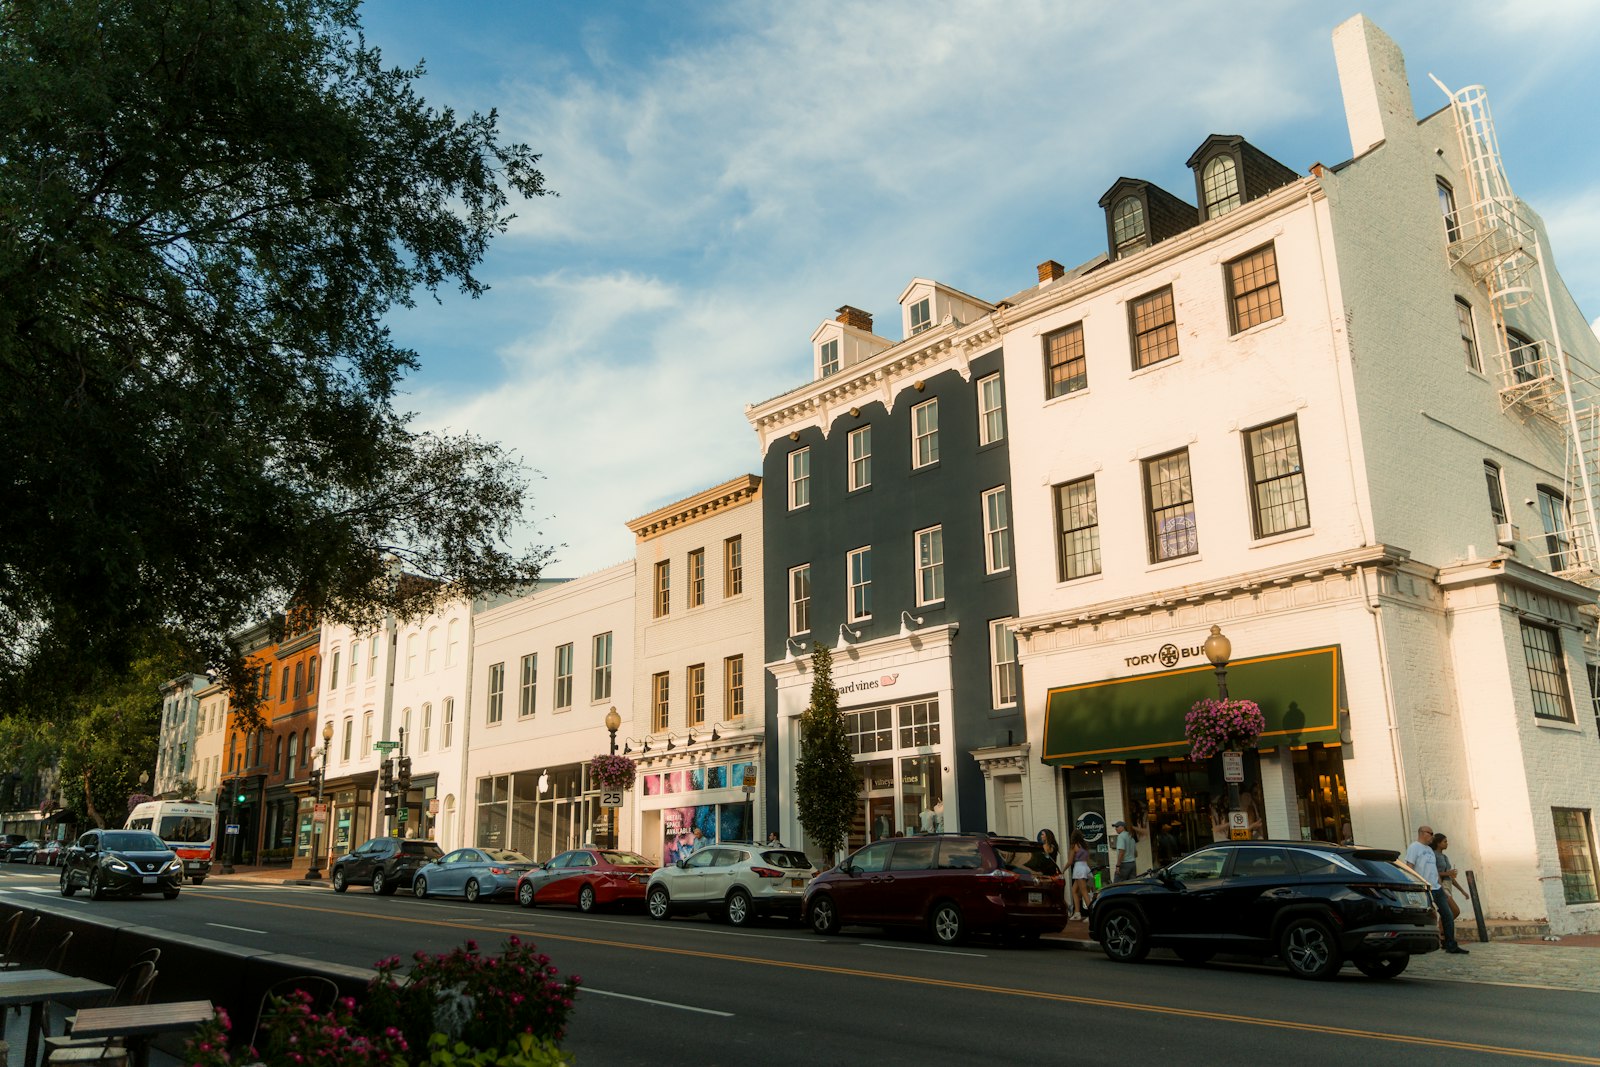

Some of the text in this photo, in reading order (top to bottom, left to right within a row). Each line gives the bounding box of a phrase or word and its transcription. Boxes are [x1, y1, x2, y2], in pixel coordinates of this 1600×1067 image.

[1124, 653, 1158, 667] TORY
[855, 680, 879, 691] vines
[603, 793, 621, 804] 25
[666, 827, 692, 835] AVAILABLE
